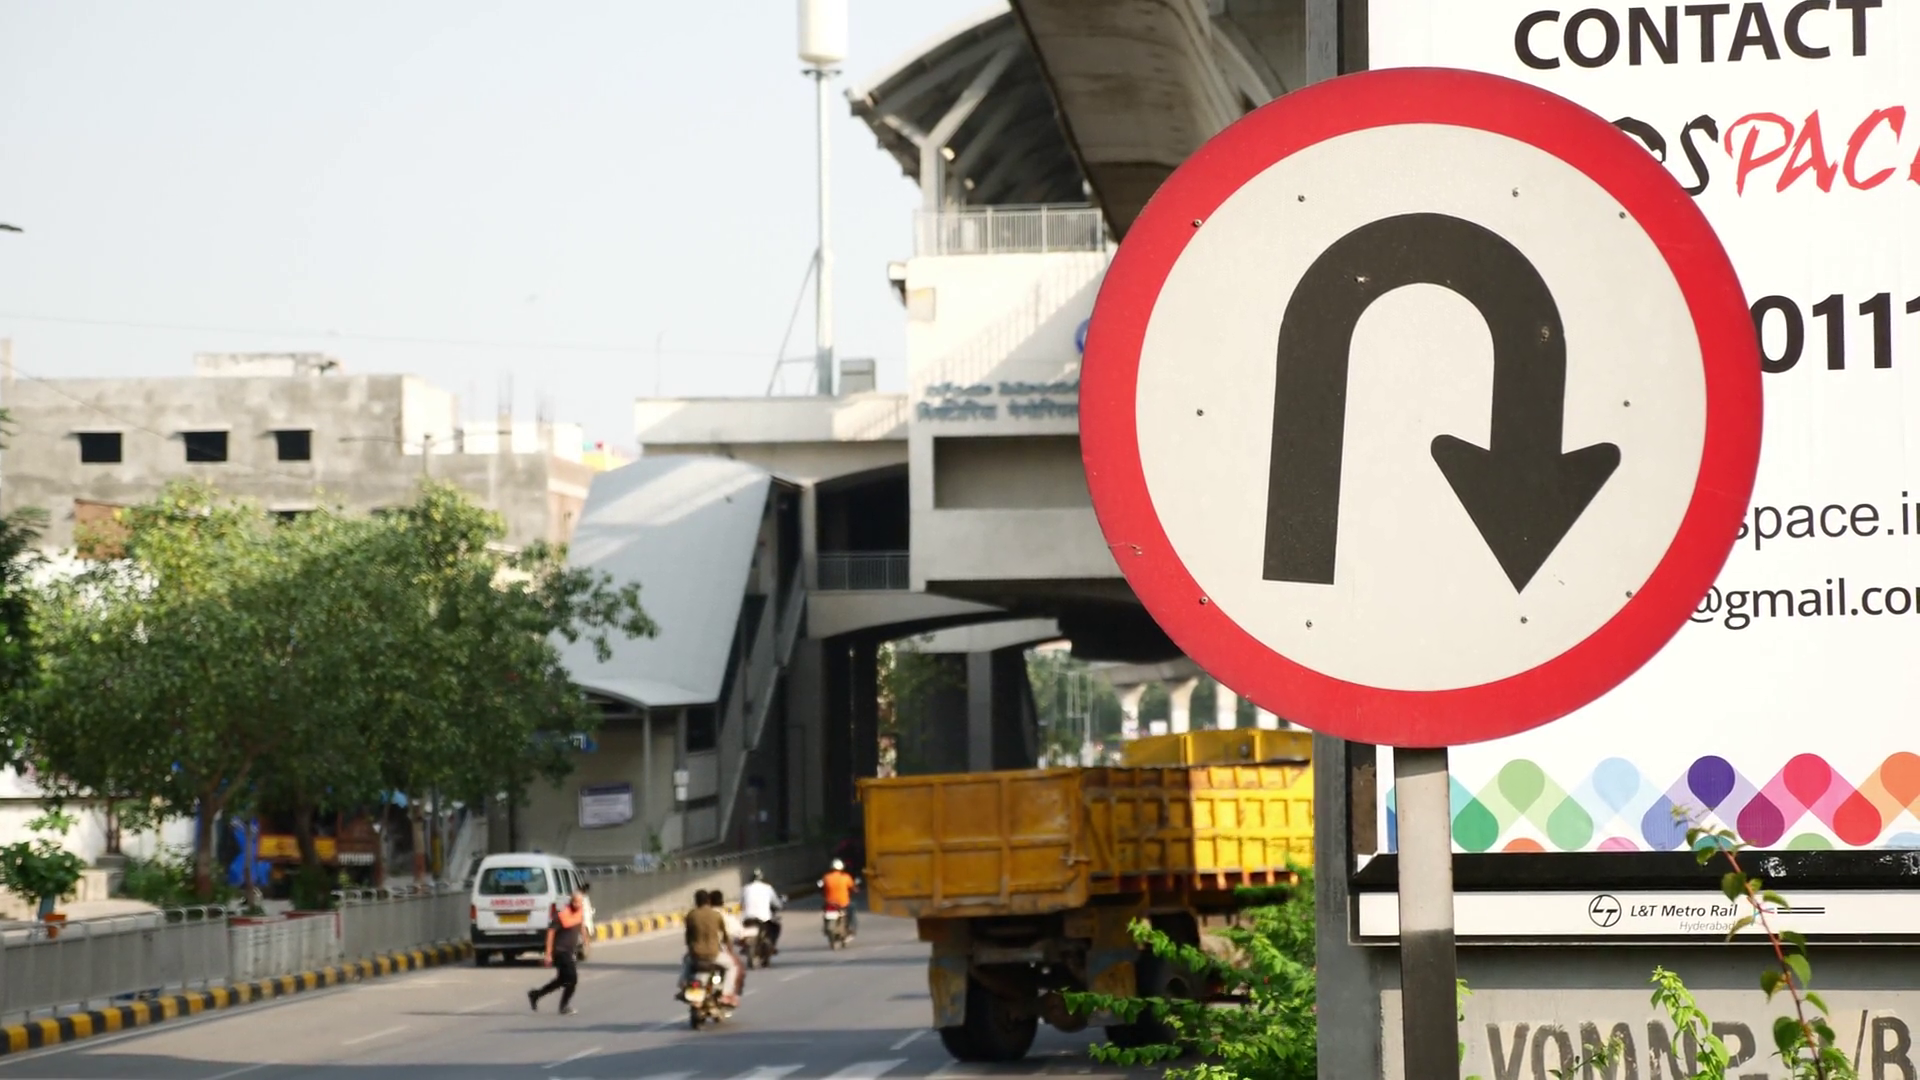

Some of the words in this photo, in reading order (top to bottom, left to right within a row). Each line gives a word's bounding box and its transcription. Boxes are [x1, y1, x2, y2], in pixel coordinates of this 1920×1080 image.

[1514, 0, 1882, 70] CONTACT
[1689, 577, 1920, 631] @gmail.co
[1630, 904, 1658, 917] L&T
[1661, 904, 1706, 917] Metro
[1710, 903, 1738, 917] Rail
